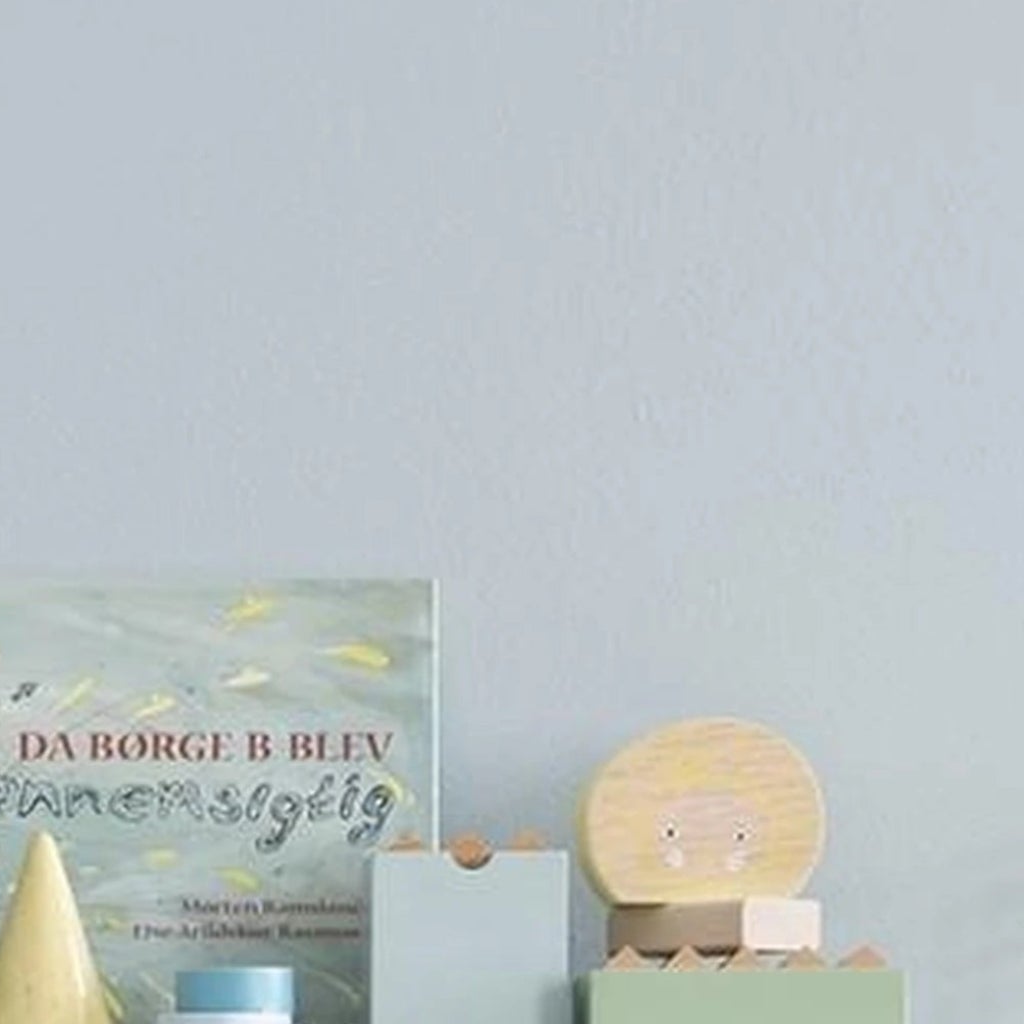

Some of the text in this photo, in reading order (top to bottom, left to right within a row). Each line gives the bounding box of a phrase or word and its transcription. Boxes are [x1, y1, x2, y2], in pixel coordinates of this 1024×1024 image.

[18, 730, 395, 763] DA BØRGE B BLEV
